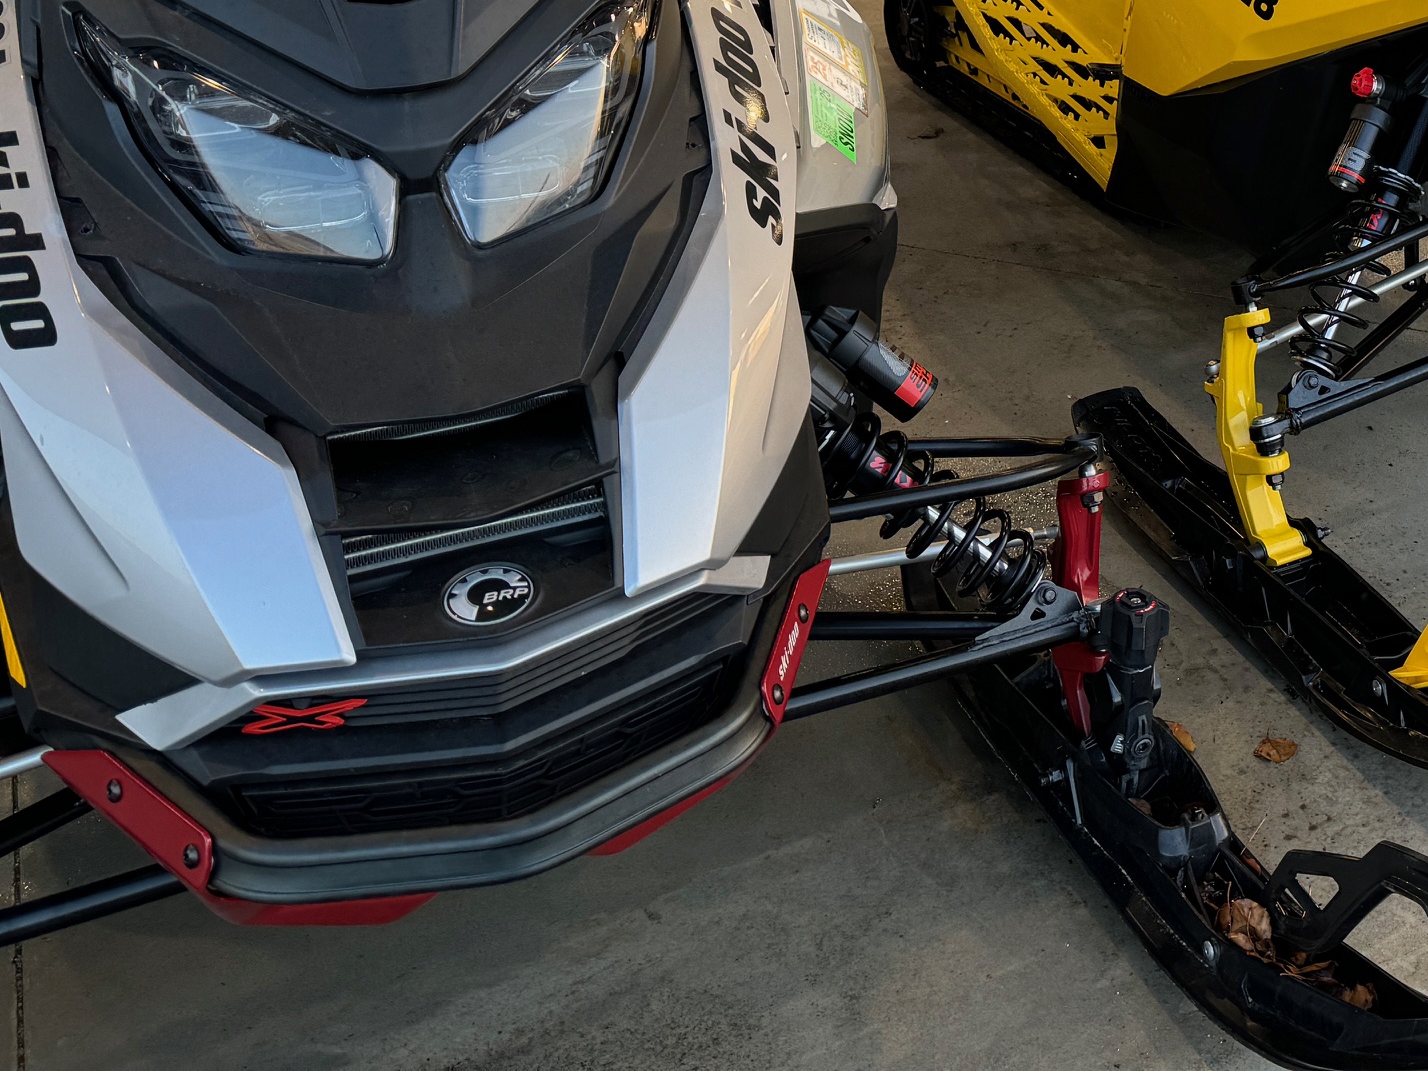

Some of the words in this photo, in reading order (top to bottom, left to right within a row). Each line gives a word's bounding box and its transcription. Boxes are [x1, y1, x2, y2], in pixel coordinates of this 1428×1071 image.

[711, 7, 783, 246] ski-doo
[838, 102, 855, 153] SNOW
[482, 585, 530, 605] BRP
[778, 621, 800, 681] ski-doo
